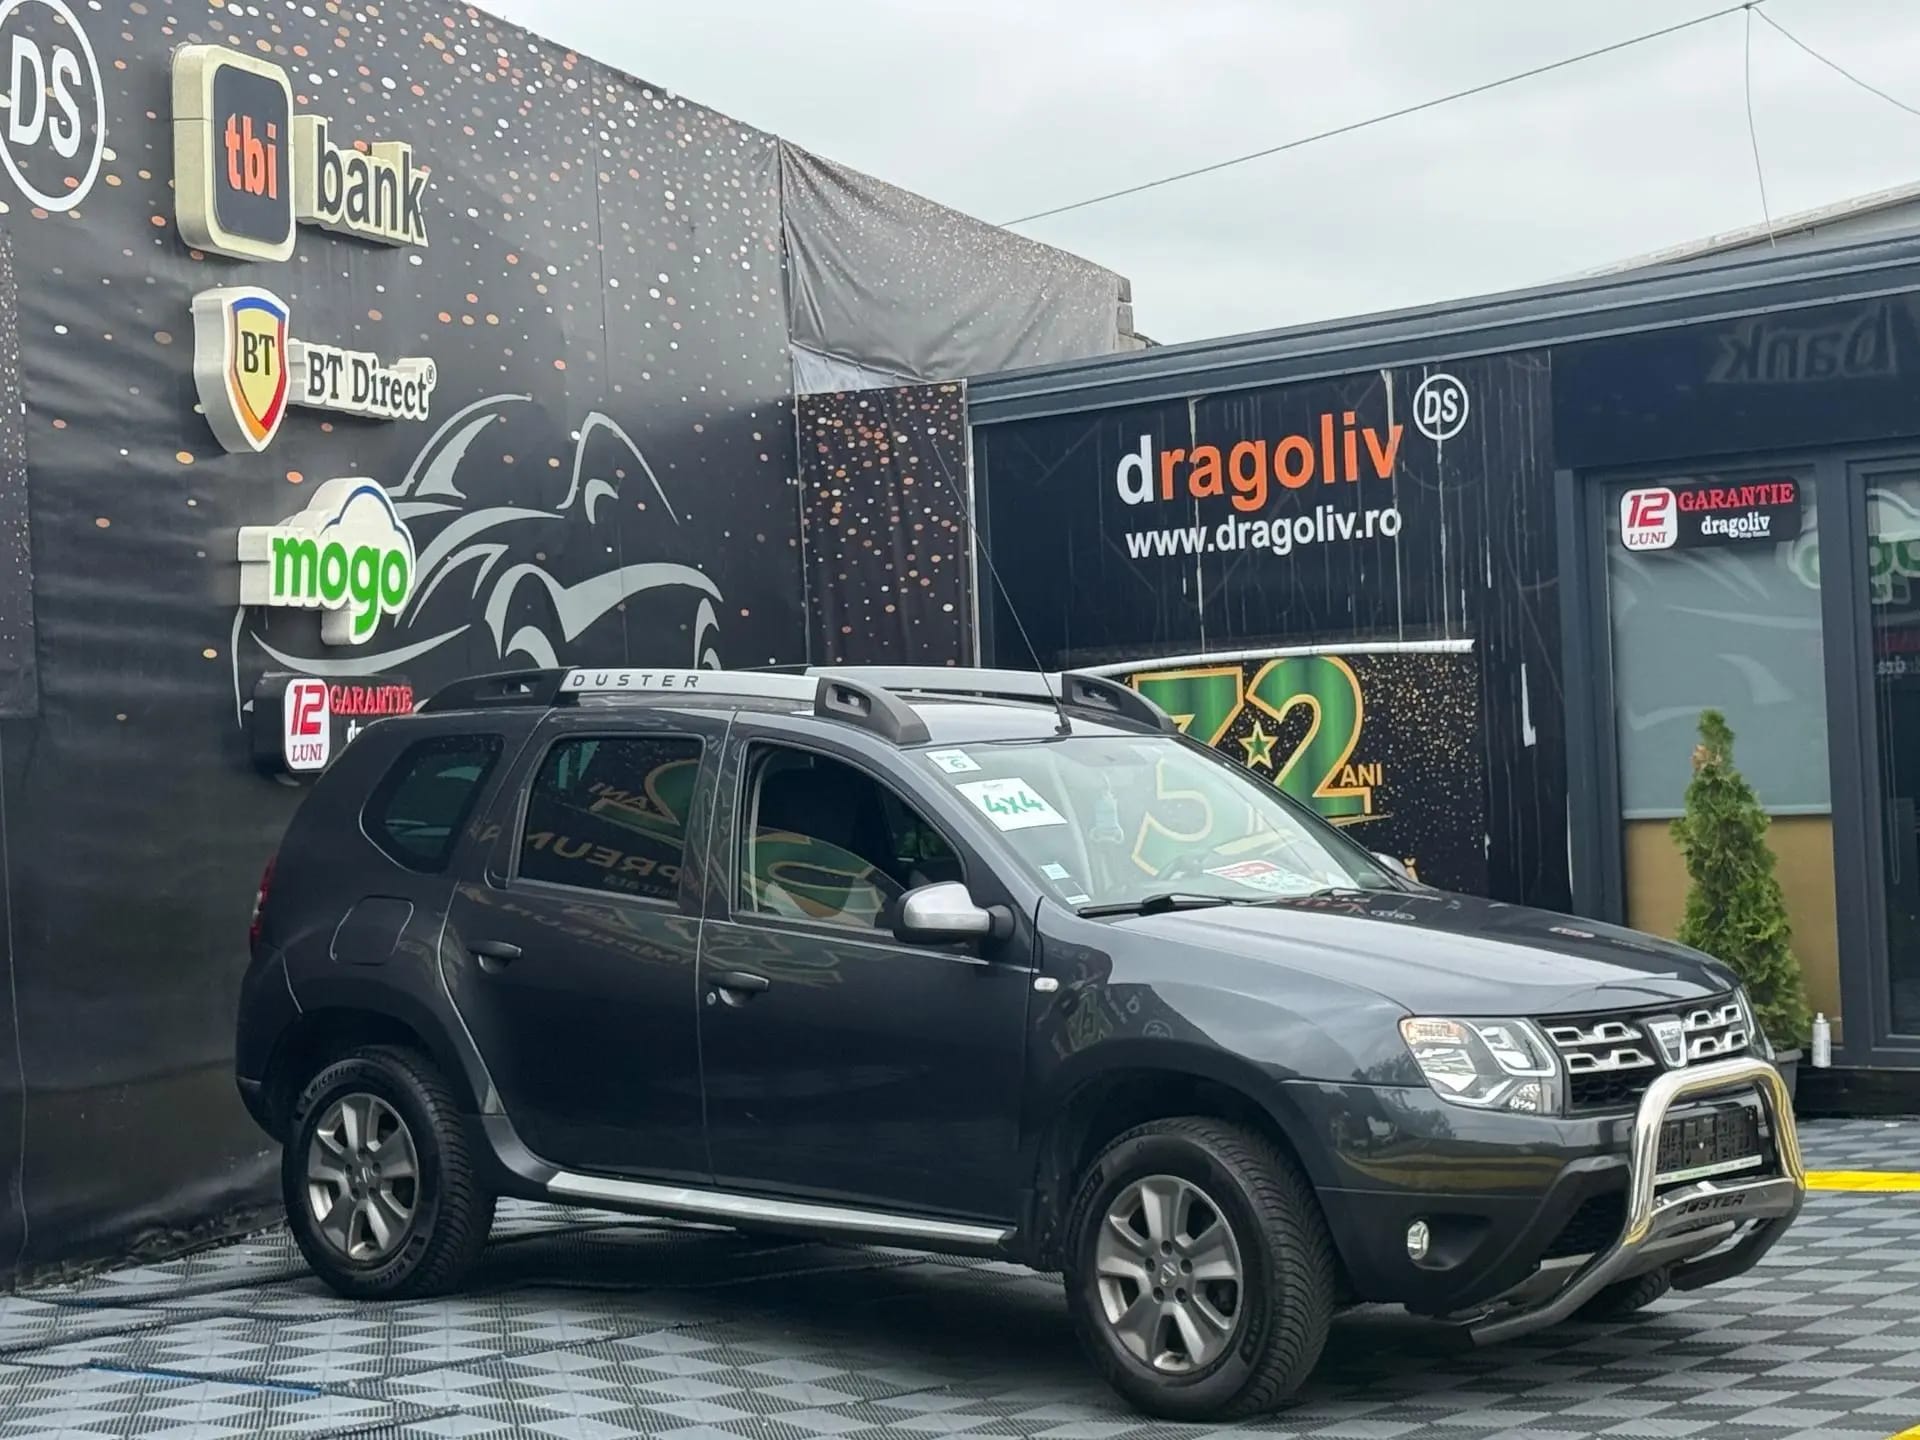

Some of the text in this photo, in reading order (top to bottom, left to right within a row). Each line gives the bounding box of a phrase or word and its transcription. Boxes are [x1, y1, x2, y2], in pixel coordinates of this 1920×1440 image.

[10, 34, 83, 158] DS
[225, 114, 428, 239] tbi bank
[241, 331, 275, 376] BT
[308, 351, 343, 399] BT
[1423, 390, 1459, 425] DS
[1116, 411, 1404, 511] dragoliv
[1627, 483, 1795, 529] 12 GARANTIE
[1701, 511, 1771, 539] dragoliv
[1126, 504, 1402, 559] www.dragoliv.ro
[1628, 530, 1667, 546] LUNI
[273, 536, 408, 635] mogo
[572, 673, 700, 688] DUSTER
[290, 684, 414, 736] 12 GARANTIE
[291, 743, 323, 762] LUNI
[1340, 763, 1384, 787] ANI
